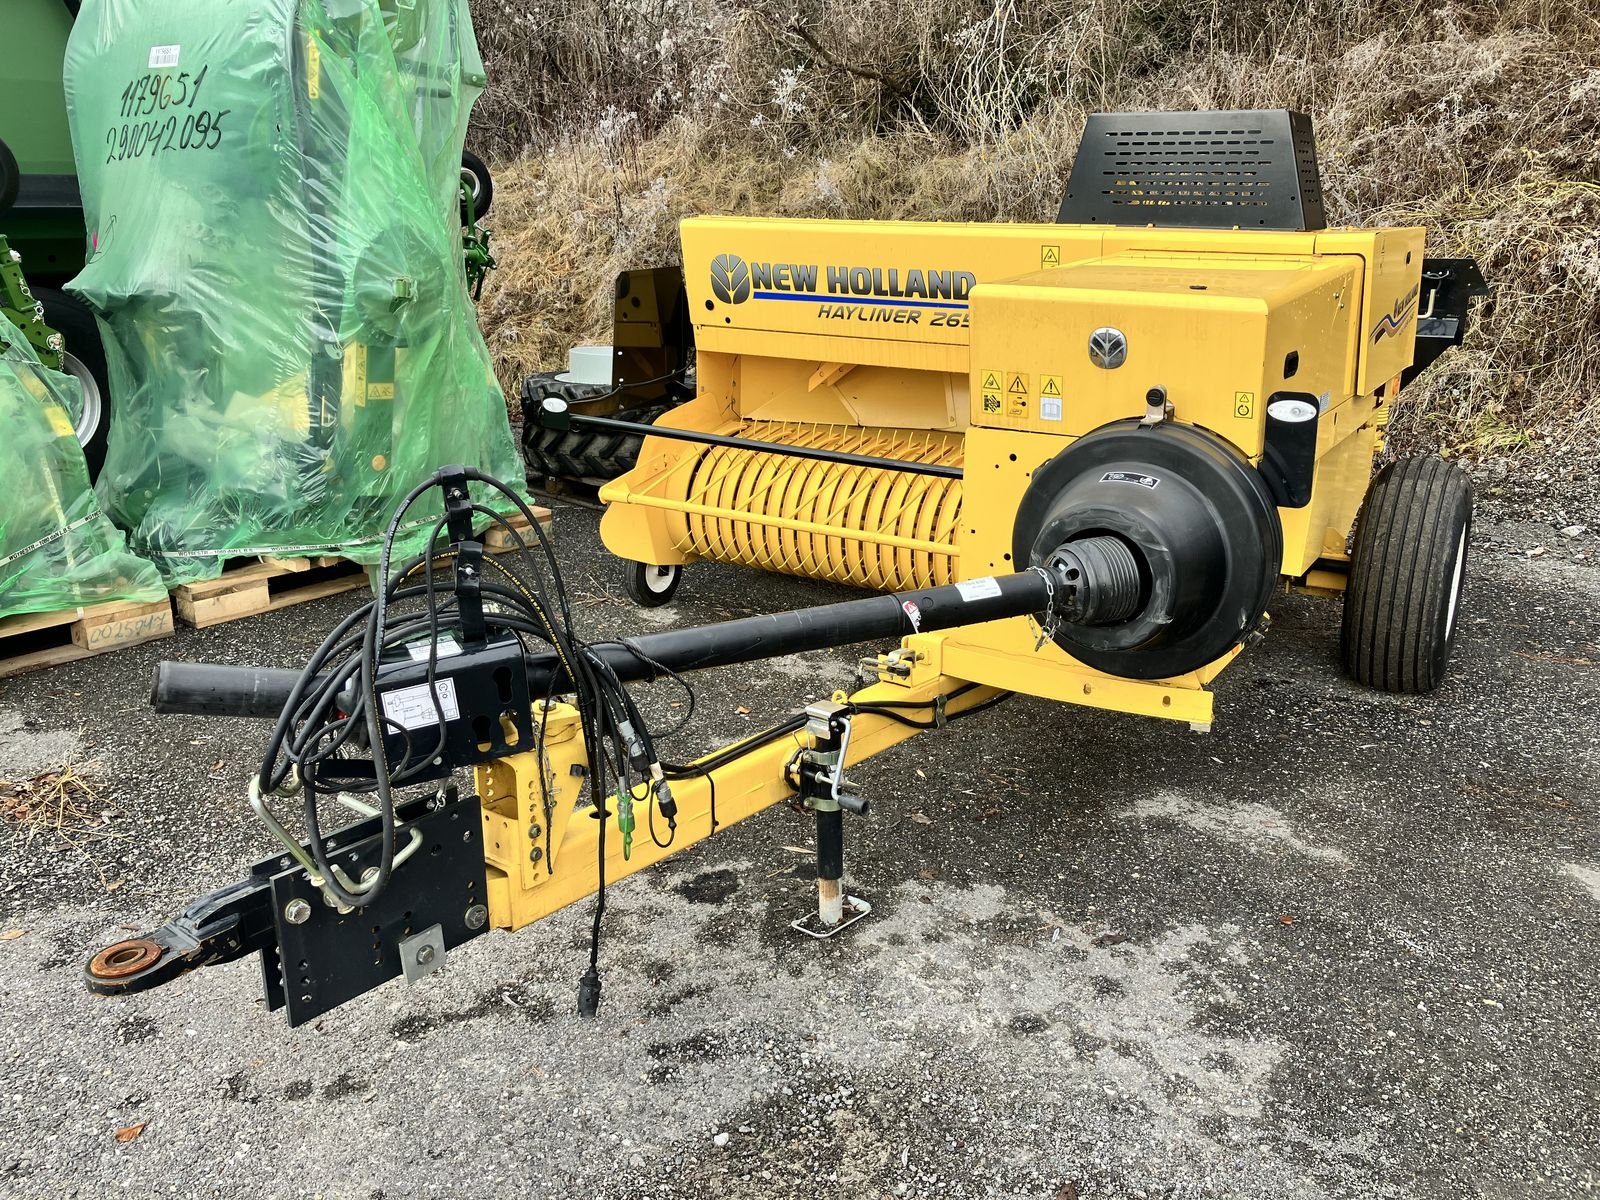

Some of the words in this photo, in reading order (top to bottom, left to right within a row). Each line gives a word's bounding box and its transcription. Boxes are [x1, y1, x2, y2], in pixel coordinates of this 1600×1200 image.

[120, 64, 208, 117] 1179651
[106, 110, 231, 164] 290042095
[751, 262, 818, 292] NEW
[826, 266, 976, 300] HOLLAND
[818, 304, 922, 325] HAYLINER
